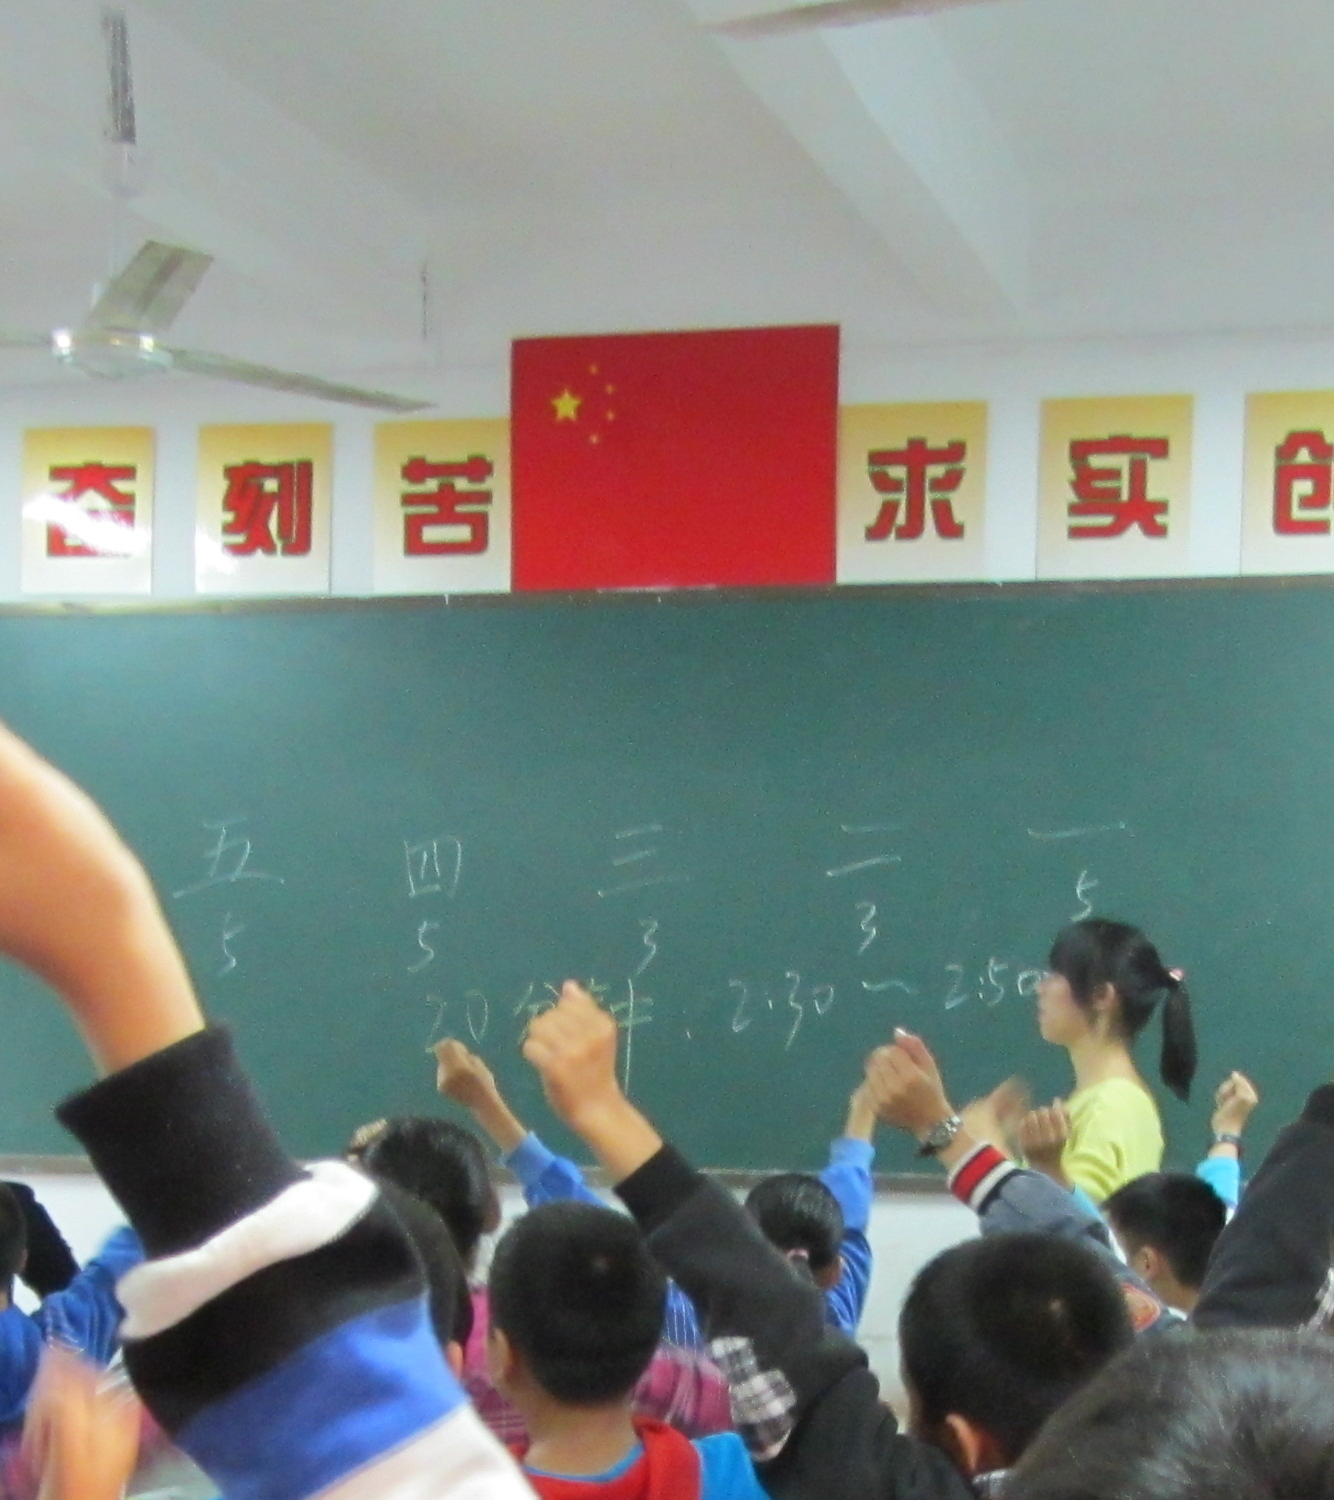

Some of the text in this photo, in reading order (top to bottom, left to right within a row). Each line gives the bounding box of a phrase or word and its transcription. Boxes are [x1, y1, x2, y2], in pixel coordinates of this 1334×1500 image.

[173, 816, 285, 899] 五
[403, 832, 463, 898] 四
[597, 822, 692, 898] 三
[825, 822, 906, 879] 二
[406, 919, 442, 974] 5
[634, 918, 660, 979] 3
[854, 901, 879, 957] 3
